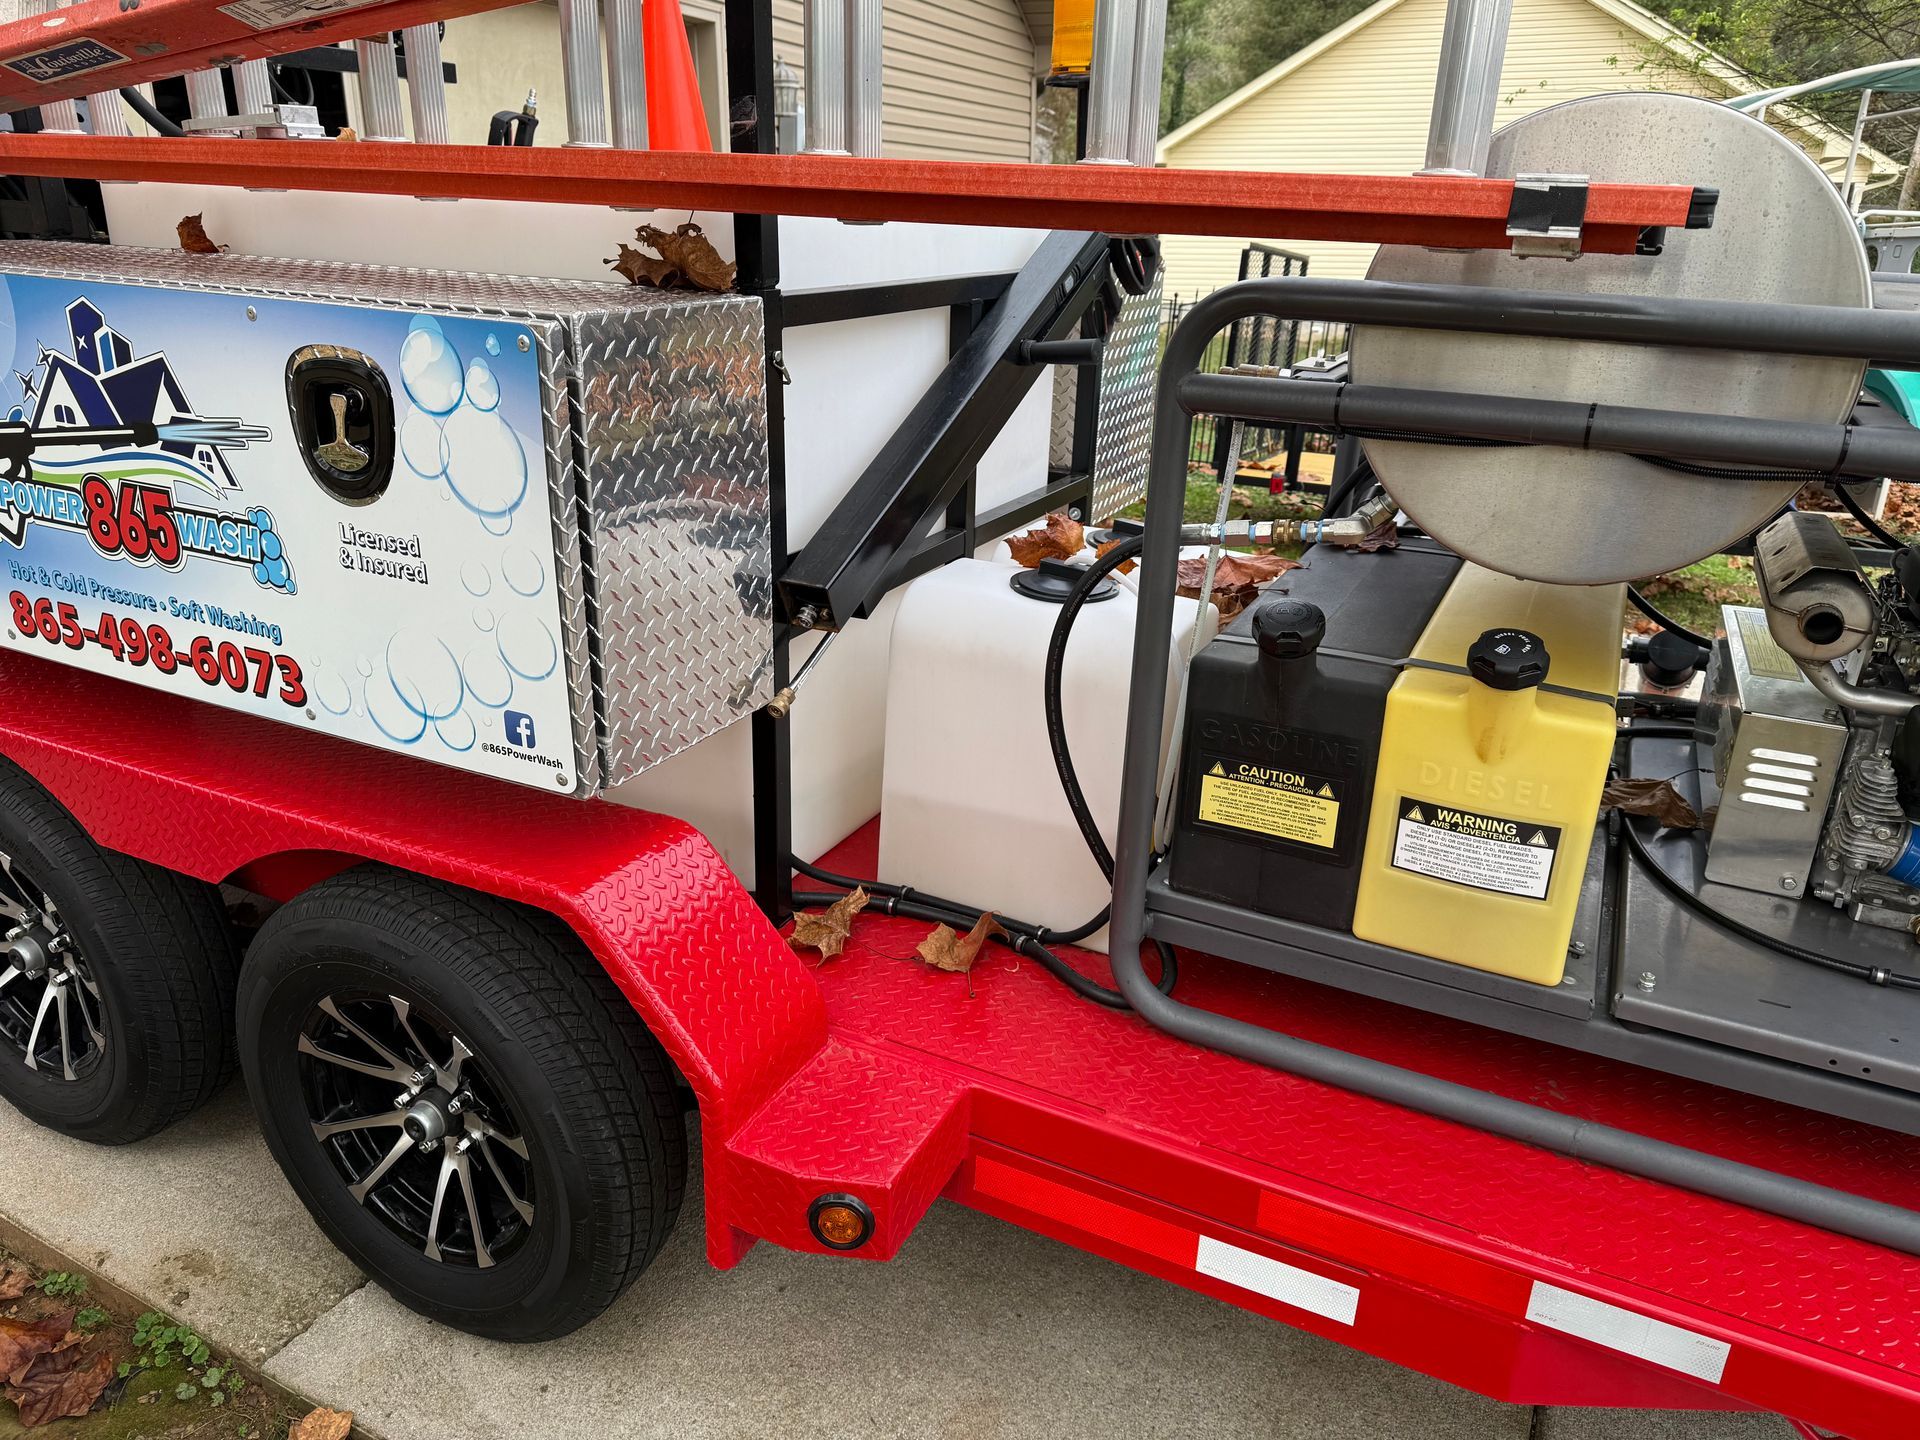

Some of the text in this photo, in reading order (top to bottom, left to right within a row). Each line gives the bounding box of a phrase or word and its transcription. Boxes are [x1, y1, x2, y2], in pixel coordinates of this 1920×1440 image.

[26, 47, 105, 77] Louisville
[0, 479, 261, 563] POWER 865 WASH
[338, 522, 421, 558] Licensed
[339, 547, 428, 584] & Insured
[8, 560, 283, 646] Hot & Cold Pressure Soft Washing
[9, 590, 308, 708] 865-498-6073
[481, 743, 563, 769] @865PowerWash
[1201, 718, 1360, 767] GASOLINE
[1229, 773, 1265, 785] ATTENTION
[1269, 781, 1314, 795] PRECAUCIÓN
[1239, 764, 1305, 787] CAUTION
[1418, 761, 1553, 810] DIESEL
[1430, 819, 1450, 830] AVIS
[1456, 826, 1521, 844] ADVERTENCIA
[1437, 808, 1518, 835] WARNING
[1443, 831, 1472, 841] STANDARD
[1404, 833, 1426, 842] INSPECT
[1439, 841, 1462, 850] CHANGE
[1502, 855, 1542, 865] PERIODICALLY
[1410, 829, 1434, 838] DIESEL#1
[1456, 840, 1482, 849] DIESEL#2
[1497, 848, 1529, 858] REMEMBER
